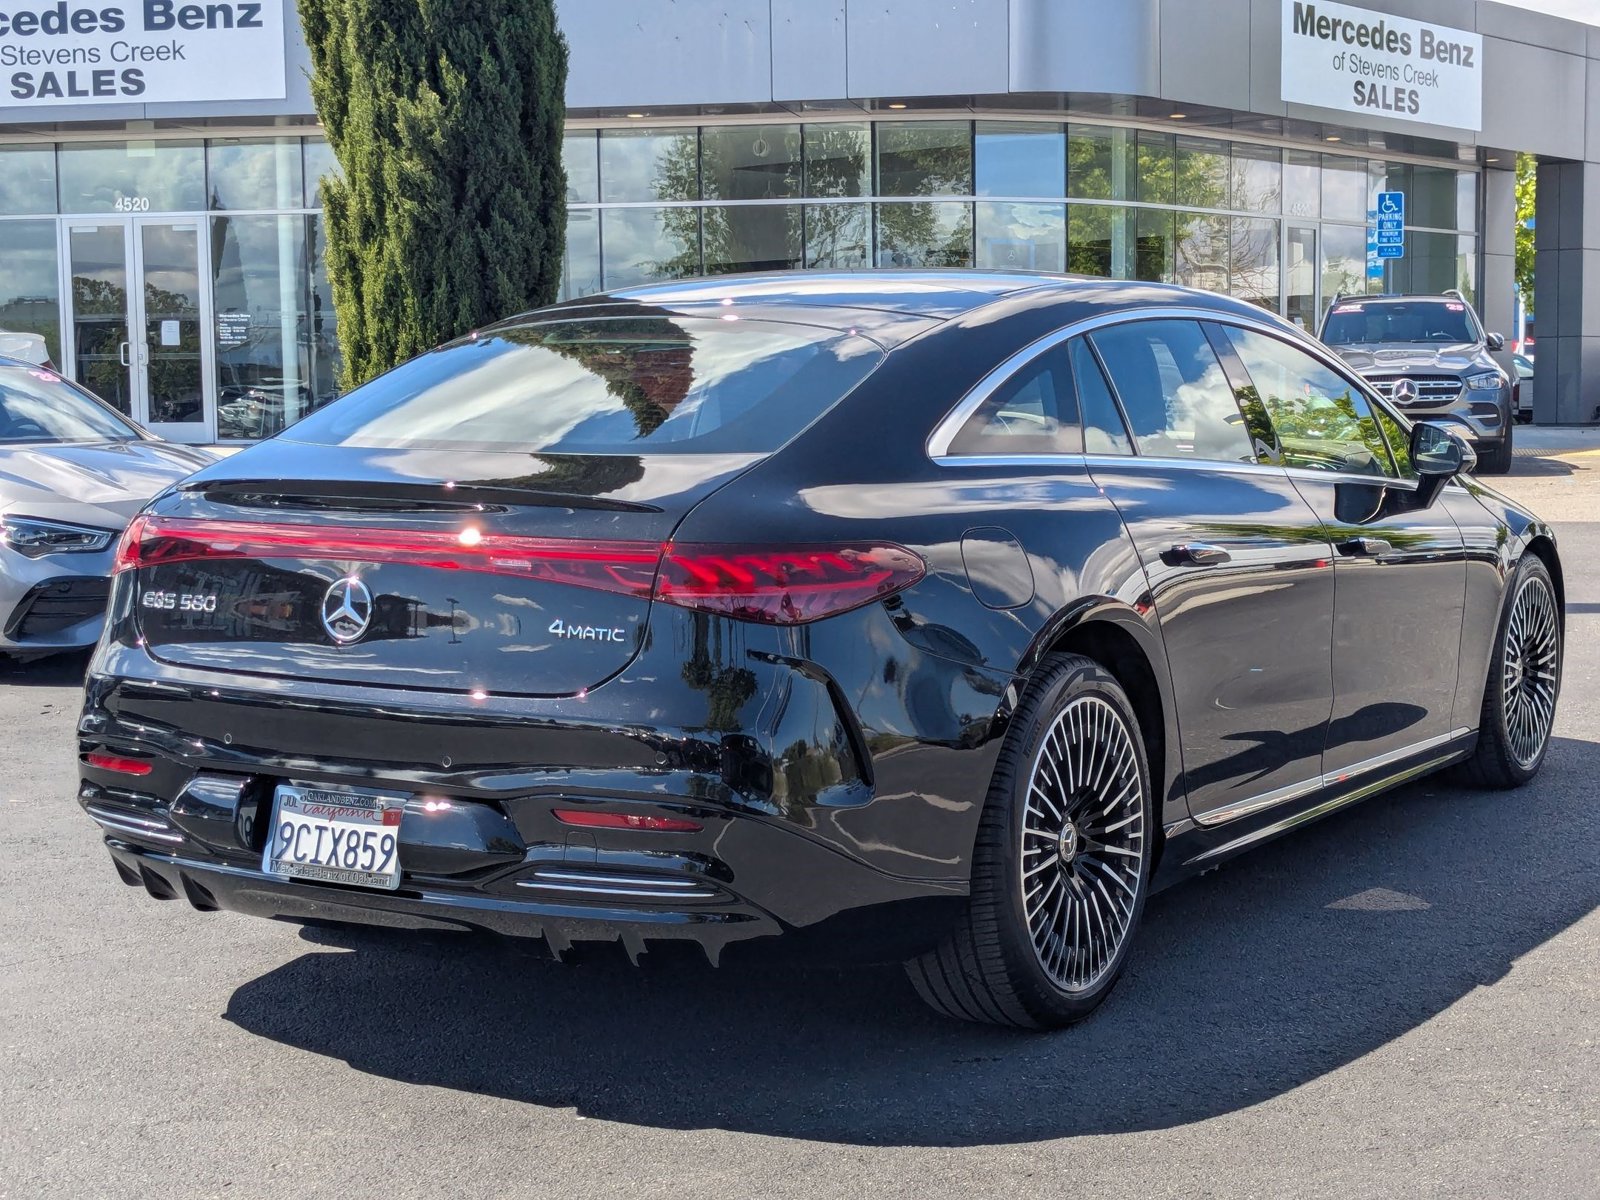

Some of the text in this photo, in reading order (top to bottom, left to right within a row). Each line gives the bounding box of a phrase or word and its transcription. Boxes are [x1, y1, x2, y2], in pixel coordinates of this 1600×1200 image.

[143, 0, 264, 32] Benz
[1293, 1, 1475, 68] Mercedes Benz
[0, 39, 187, 66] Stevens Creek
[1332, 51, 1439, 89] of Stevens Creek
[10, 68, 147, 100] SALES
[1353, 79, 1420, 115] SALES
[115, 197, 150, 211] 4520
[1378, 213, 1402, 221] PARKING
[1382, 221, 1398, 229] ONLY
[142, 590, 216, 613] EQS 580
[548, 618, 625, 642] 4MATIC
[284, 795, 298, 807] JUL
[306, 791, 377, 809] OAKLANDBENZ.COM
[276, 821, 395, 871] 9CIX859
